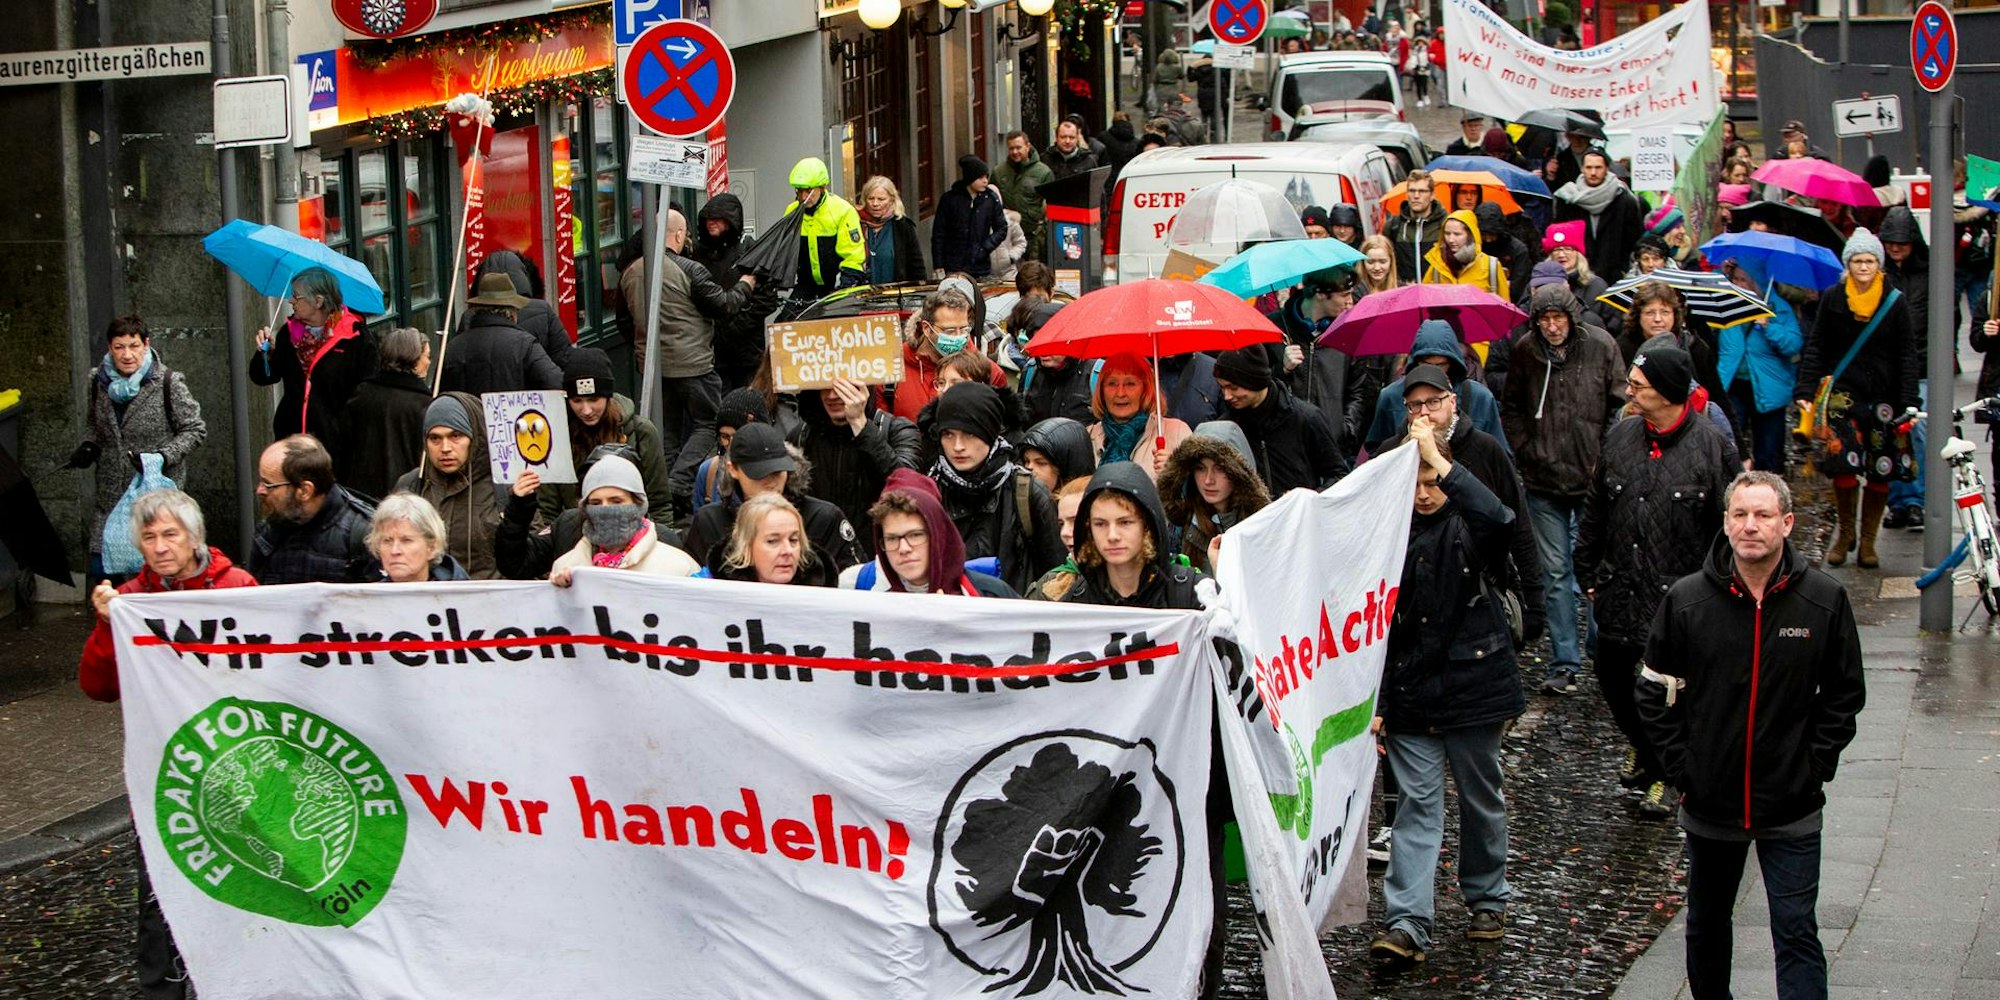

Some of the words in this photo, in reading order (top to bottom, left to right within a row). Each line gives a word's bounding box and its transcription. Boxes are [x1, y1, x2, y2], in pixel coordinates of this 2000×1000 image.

[0, 49, 205, 79] aurenzgittergäßchen
[1500, 67, 1537, 90] man
[1550, 81, 1603, 99] unsere
[1609, 75, 1650, 98] Enkel
[1603, 101, 1640, 121] icht
[1639, 136, 1667, 148] OMAS
[1636, 153, 1670, 165] GEGEN
[1634, 170, 1673, 181] RECHTS
[1133, 192, 1187, 208] GETR
[782, 331, 826, 352] Eure
[831, 320, 886, 349] Kohle
[791, 344, 844, 366] macht
[799, 355, 887, 382] atemlos
[493, 409, 508, 421] DIE
[489, 421, 513, 444] ZEIT
[145, 617, 271, 669] Wir
[300, 608, 576, 667] streiken
[594, 606, 699, 677] bis
[725, 619, 826, 682] ihr
[853, 621, 1156, 693] handelt
[194, 706, 273, 751] FOR
[280, 712, 399, 817] FUTURE
[164, 744, 234, 887] FRIDAYS
[405, 774, 549, 836] Wir
[570, 775, 911, 881] handeln!
